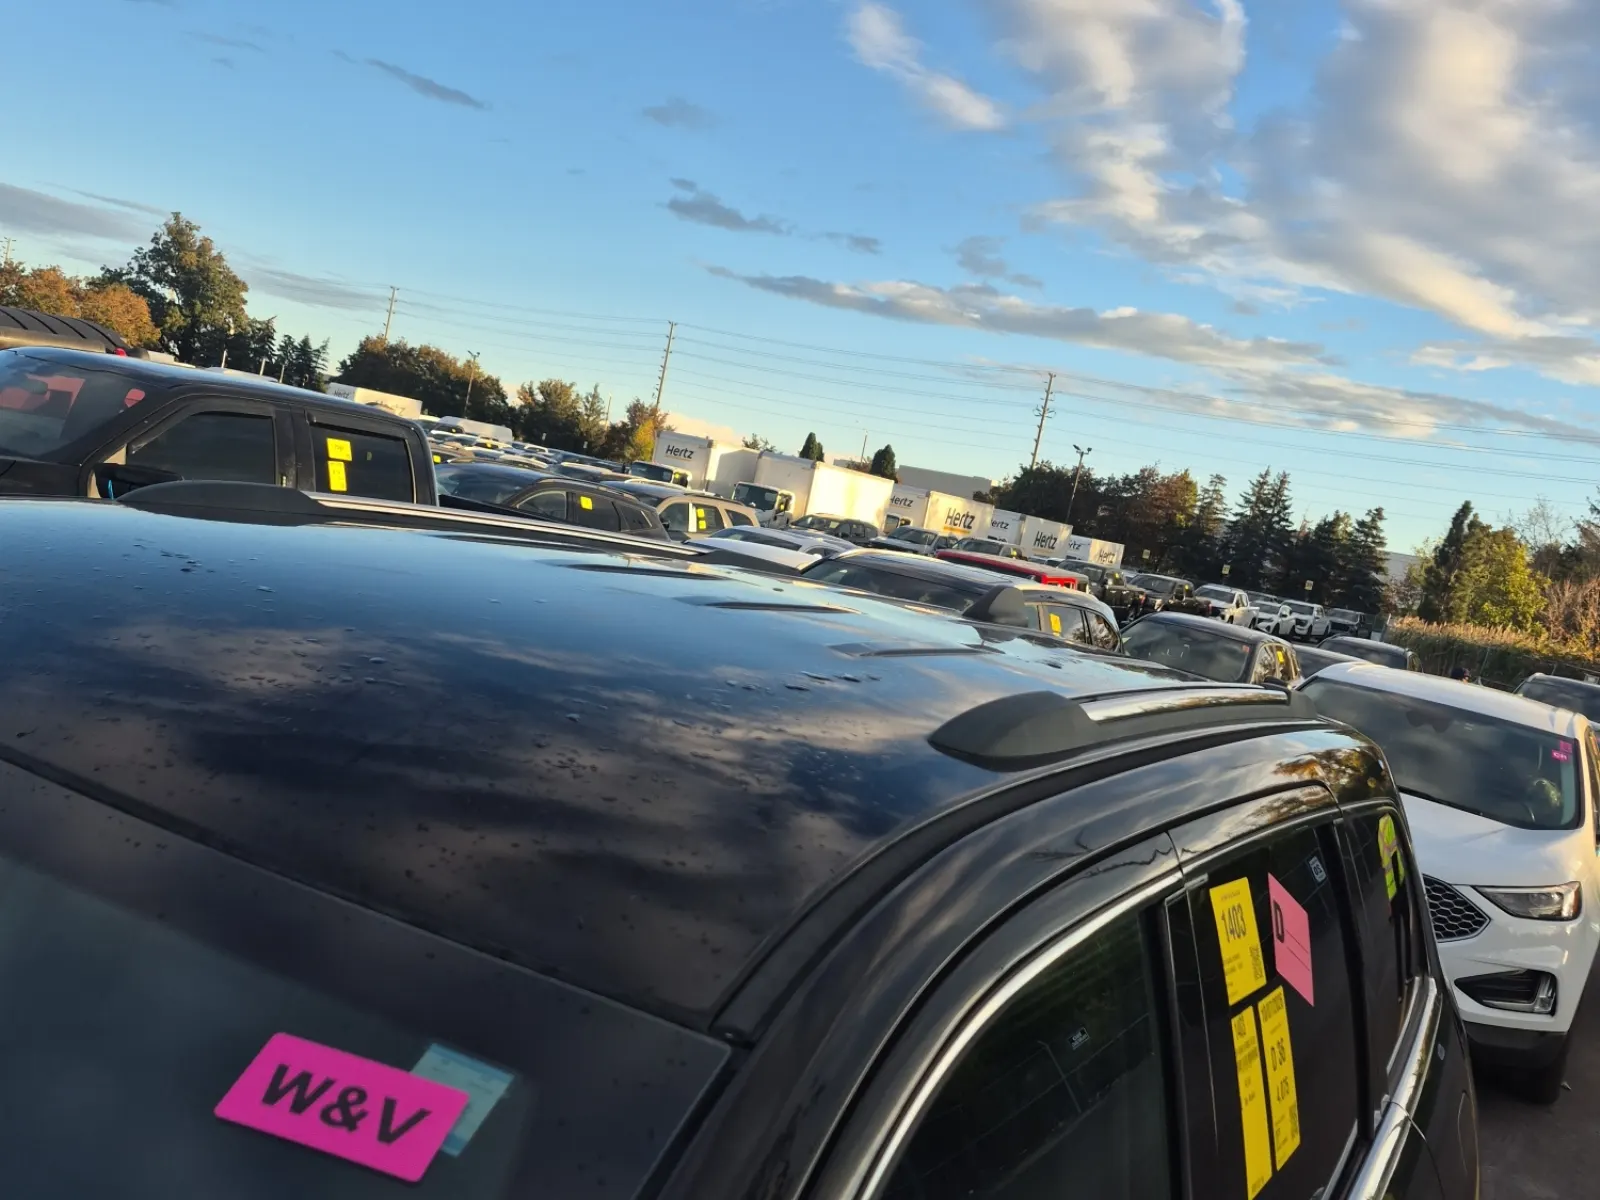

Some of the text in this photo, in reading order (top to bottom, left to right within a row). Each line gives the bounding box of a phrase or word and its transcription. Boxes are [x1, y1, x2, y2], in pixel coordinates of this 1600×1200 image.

[665, 444, 694, 459] Hertz
[945, 507, 975, 530] Hertz
[991, 519, 1010, 530] ertz
[1033, 531, 1058, 550] Hertz
[1221, 903, 1247, 944] 1403
[1273, 900, 1285, 943] D
[261, 1063, 433, 1145] W&V
